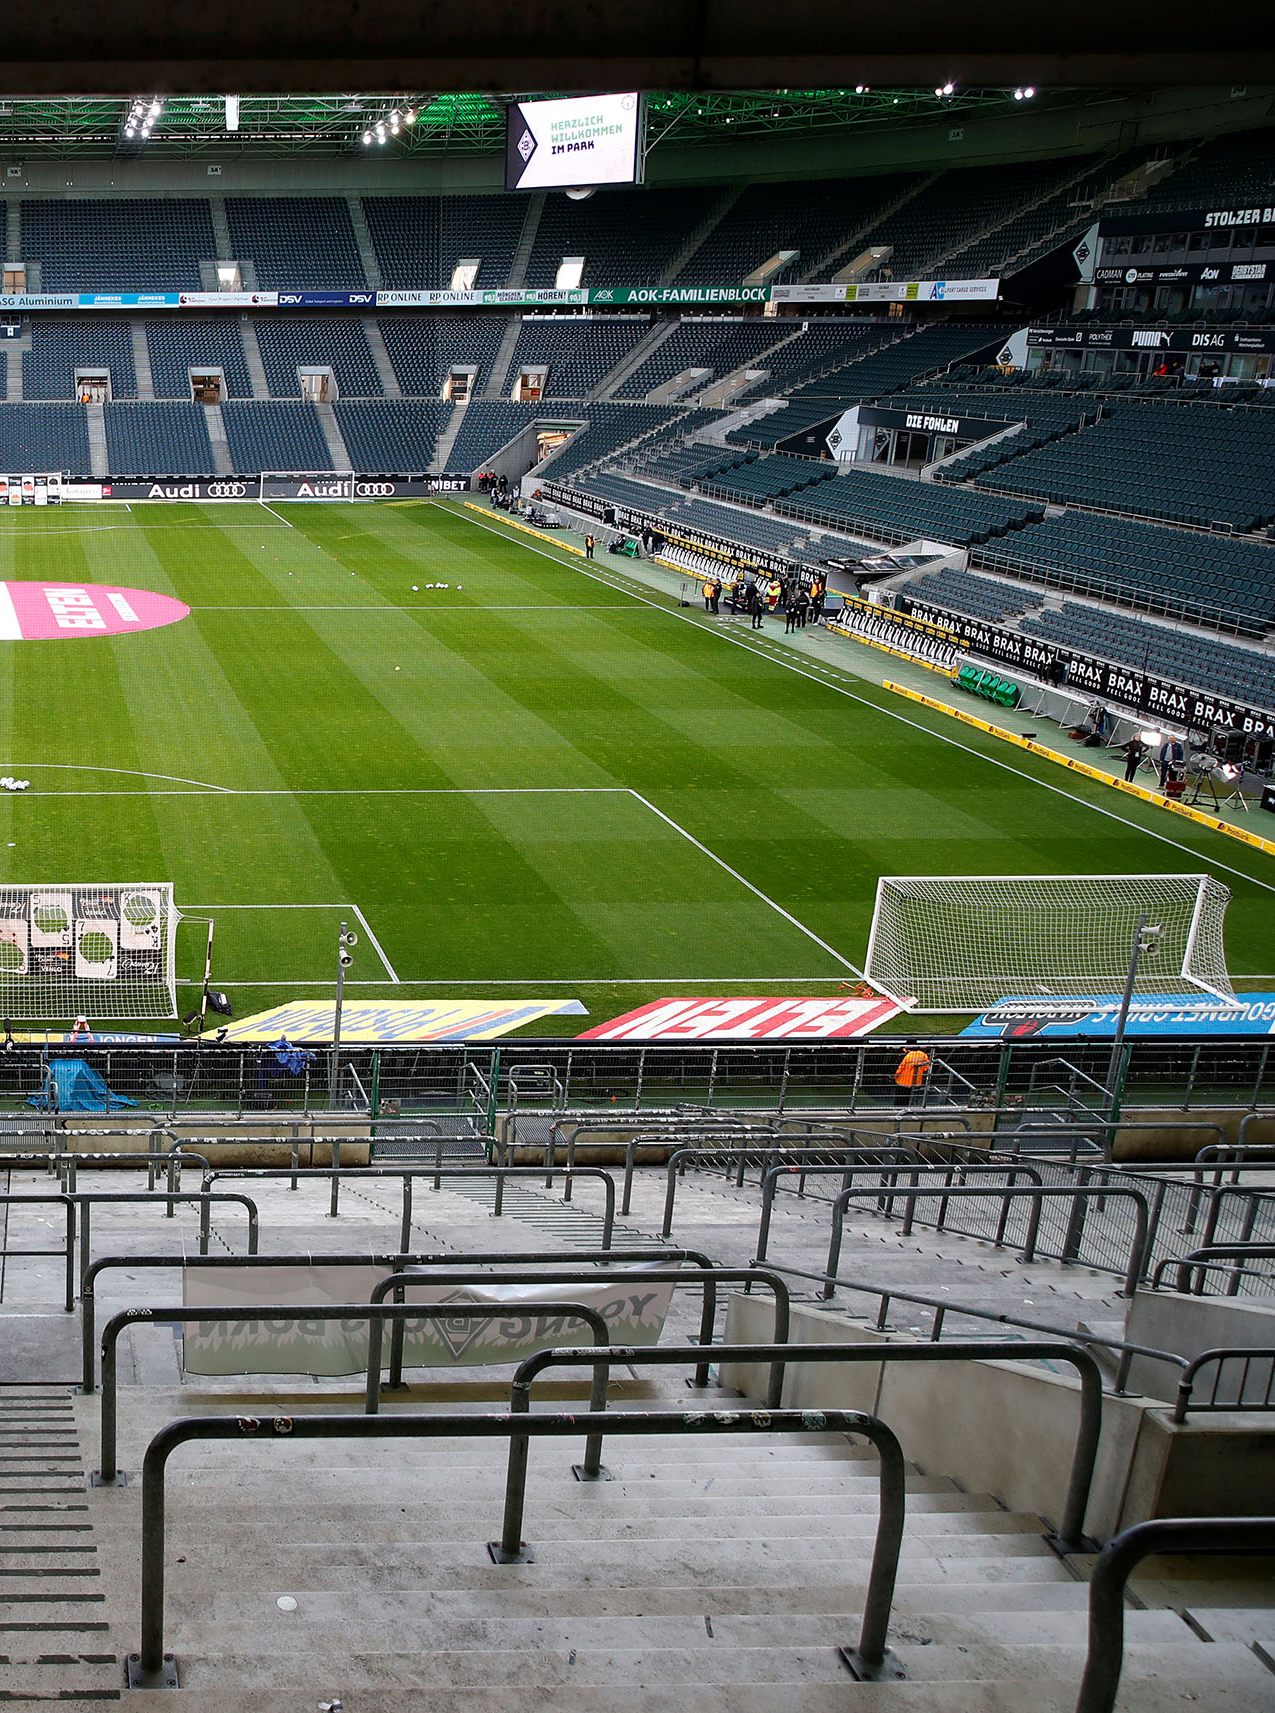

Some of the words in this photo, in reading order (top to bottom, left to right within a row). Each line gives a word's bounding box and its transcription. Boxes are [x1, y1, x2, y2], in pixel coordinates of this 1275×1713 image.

[551, 115, 603, 131] HERZLICH
[551, 124, 623, 143] WILLKOMMEN
[551, 145, 565, 155] IM
[567, 140, 595, 153] PARK
[1205, 209, 1261, 227] STOLZER
[18, 296, 73, 306] Aluminium
[279, 295, 303, 303] DSV
[349, 294, 373, 303] DSV
[378, 293, 389, 301] RP
[390, 292, 422, 302] ONLINE
[429, 292, 441, 301] RP
[443, 292, 475, 301] ONLINE
[537, 290, 566, 301] HÖREN!
[593, 290, 613, 302] AOK
[627, 288, 767, 301] AOK-FAMILIENBLOCK
[1131, 331, 1162, 346] PUMA
[906, 414, 922, 429] DIE
[922, 416, 959, 434] FOHLEN
[148, 484, 200, 498] Audi
[296, 482, 349, 497] Audi
[423, 480, 467, 491] NIBET
[720, 541, 735, 556] BRAX
[735, 546, 751, 561] BRAX
[752, 552, 769, 567] BRAX
[770, 560, 787, 575] BRAX
[42, 588, 107, 629] ELTEN
[911, 608, 934, 625] BRAX
[937, 616, 962, 634] BRAX
[963, 625, 992, 645] BRAX
[993, 635, 1023, 656] BRAX
[992, 648, 1004, 657] FEEL
[1006, 652, 1020, 662] GOOD
[1024, 646, 1055, 665] BRAX
[1069, 660, 1103, 682] BRAX
[1069, 674, 1082, 684] FEEL
[1085, 679, 1100, 690] GOOD
[1108, 673, 1144, 696] BRAX
[1107, 687, 1121, 697] FEEL
[1149, 687, 1188, 712] BRAX
[1148, 701, 1163, 712] FEEL
[1167, 706, 1186, 719] GOOD
[1194, 702, 1236, 727] BRAX
[1192, 716, 1210, 728] FEEL
[1243, 717, 1275, 739] BRA
[33, 894, 41, 905] 5
[78, 921, 85, 932] 7
